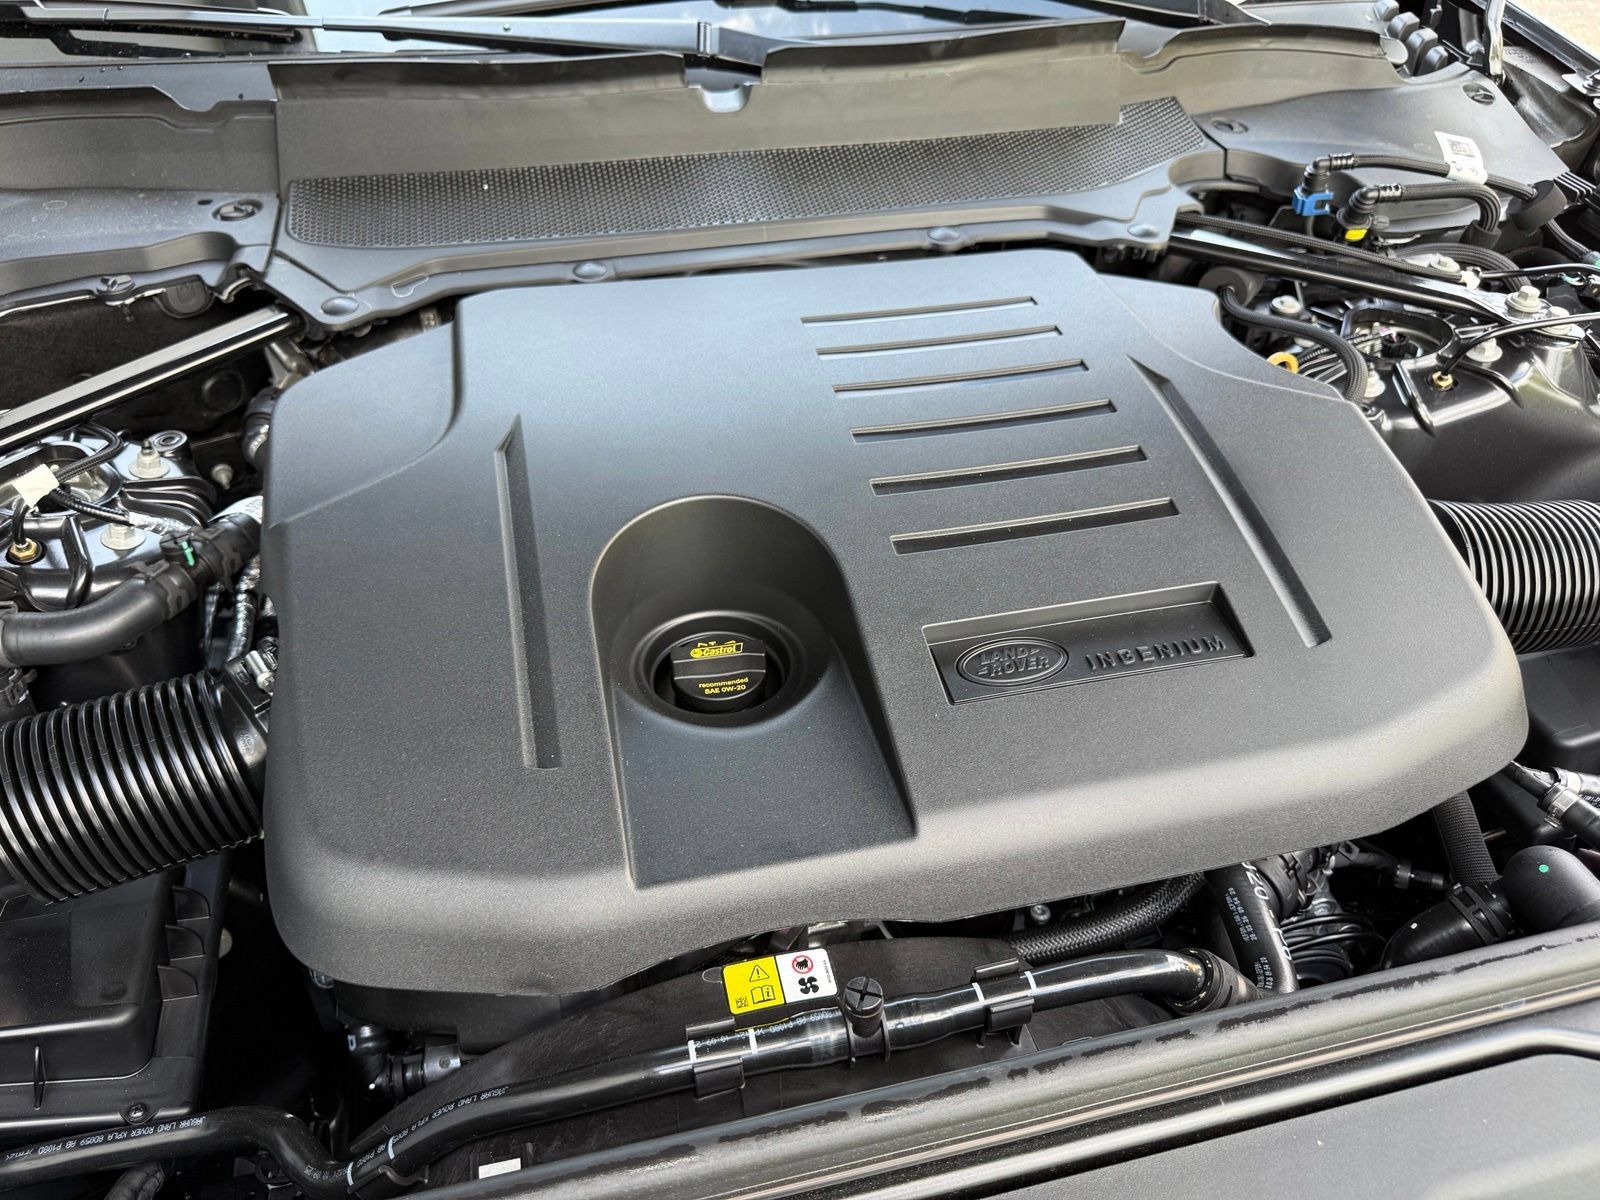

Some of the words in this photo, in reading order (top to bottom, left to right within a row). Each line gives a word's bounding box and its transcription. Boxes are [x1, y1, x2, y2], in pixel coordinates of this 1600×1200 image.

[703, 644, 737, 656] Castrol
[979, 646, 1033, 665] LAND
[1084, 635, 1228, 670] INGENIUM
[988, 655, 1051, 678] ROVER
[698, 677, 749, 688] recommended
[704, 687, 720, 695] SAE
[721, 684, 747, 693] 0W-20
[480, 1086, 509, 1100] JAGUAR
[457, 1095, 477, 1107] LAND
[431, 1102, 455, 1119] ROVER
[157, 1123, 176, 1133] LAND
[179, 1116, 207, 1129] JAGUAR
[131, 1126, 154, 1138] ROVER
